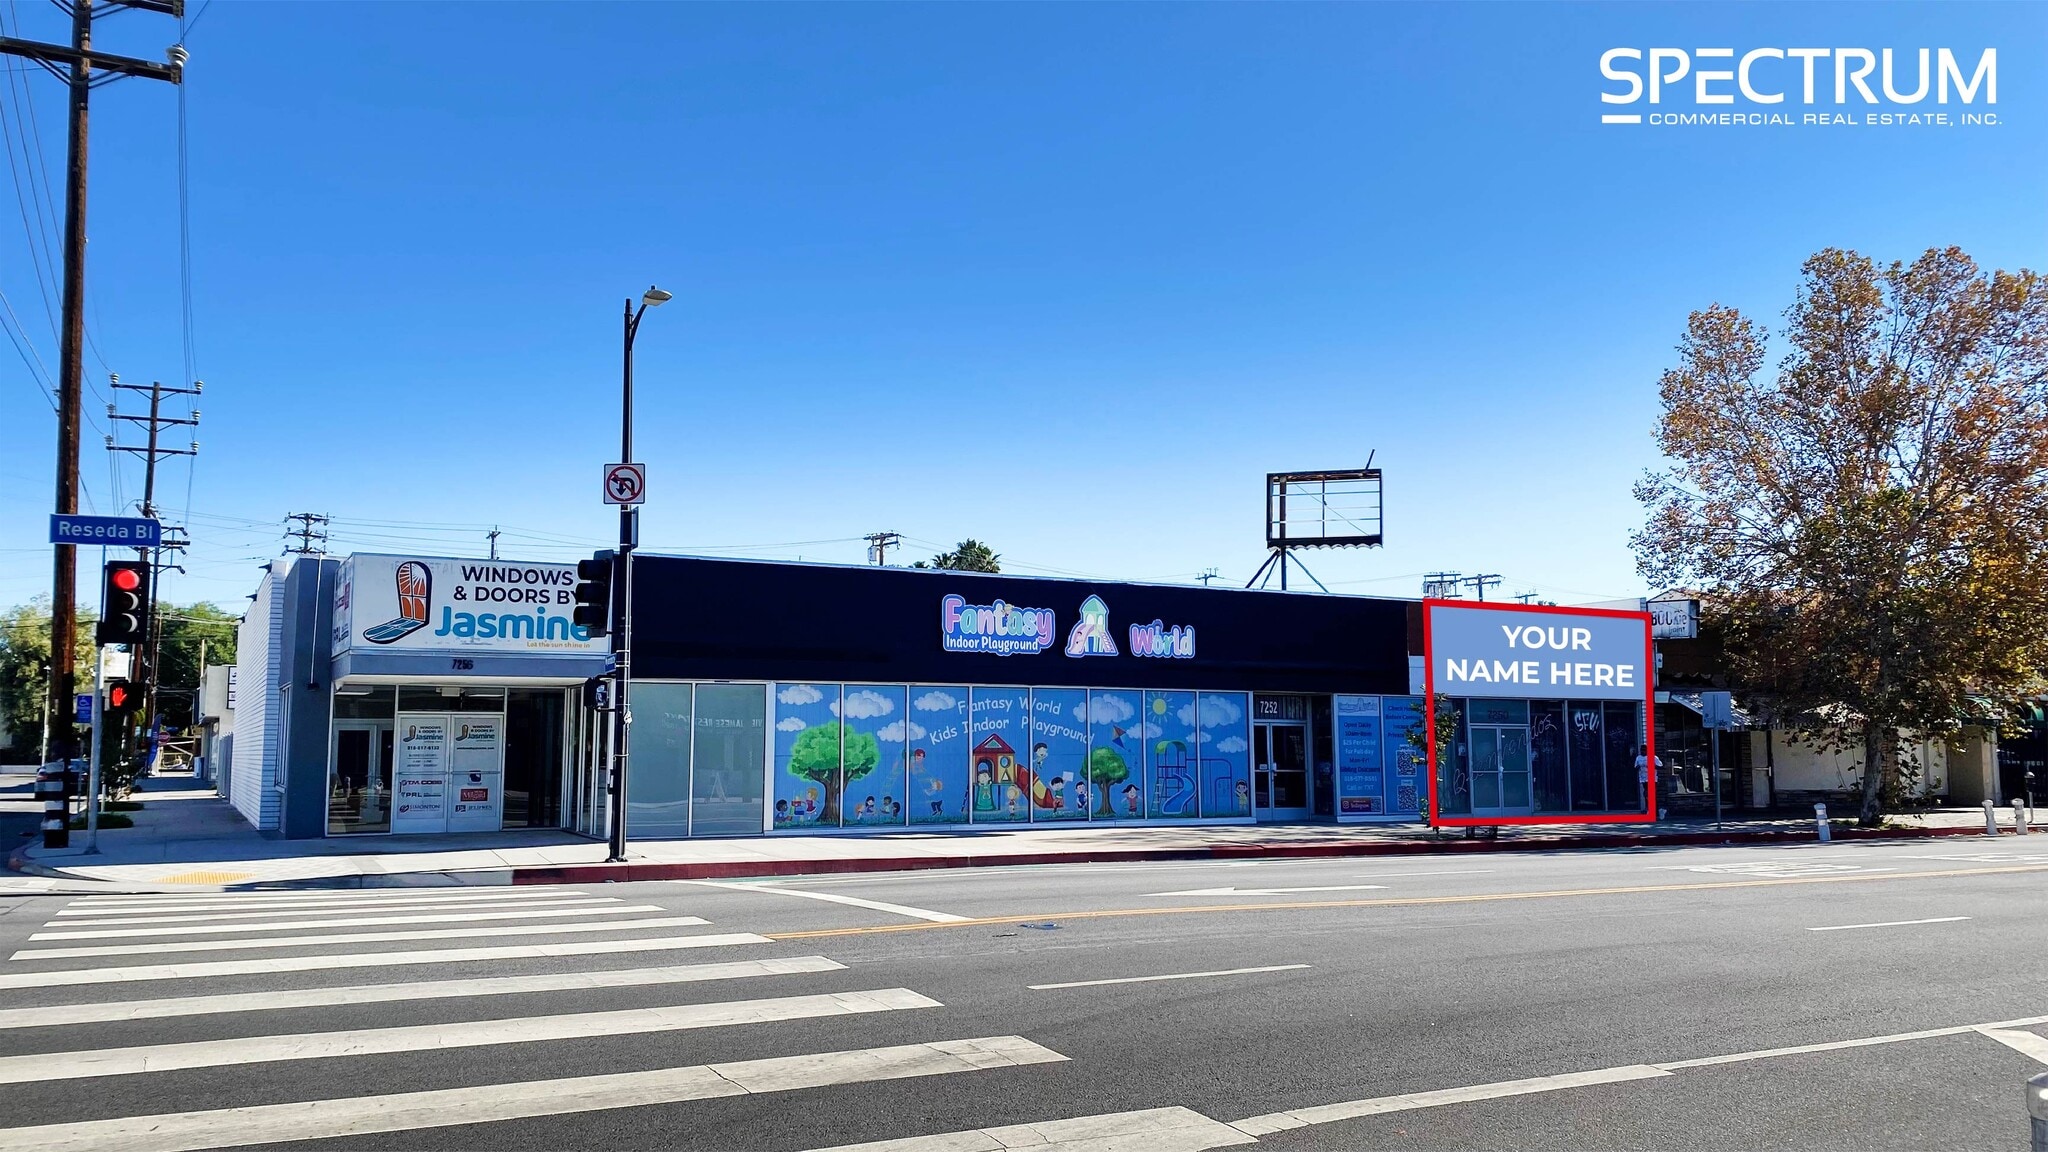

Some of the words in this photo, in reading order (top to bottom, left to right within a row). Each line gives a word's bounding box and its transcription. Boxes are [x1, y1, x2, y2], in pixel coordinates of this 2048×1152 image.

[58, 521, 129, 540] Reseda
[135, 524, 153, 540] Bl
[461, 565, 574, 586] WINDOWS
[453, 585, 467, 601] &
[474, 586, 551, 604] DOORS
[434, 605, 592, 642] Jasmine
[945, 598, 1053, 644] Fantasy
[946, 635, 980, 650] Indoor
[981, 635, 1038, 653] Playground
[1132, 624, 1193, 656] World
[451, 658, 474, 671] 7256
[957, 697, 1013, 714] Fantasy
[1018, 696, 1062, 715] World
[1260, 701, 1278, 714] 7252
[467, 732, 495, 740] Jasmine
[929, 725, 958, 746] Kids
[962, 716, 1010, 734] Indoor
[1021, 715, 1095, 745] Playground
